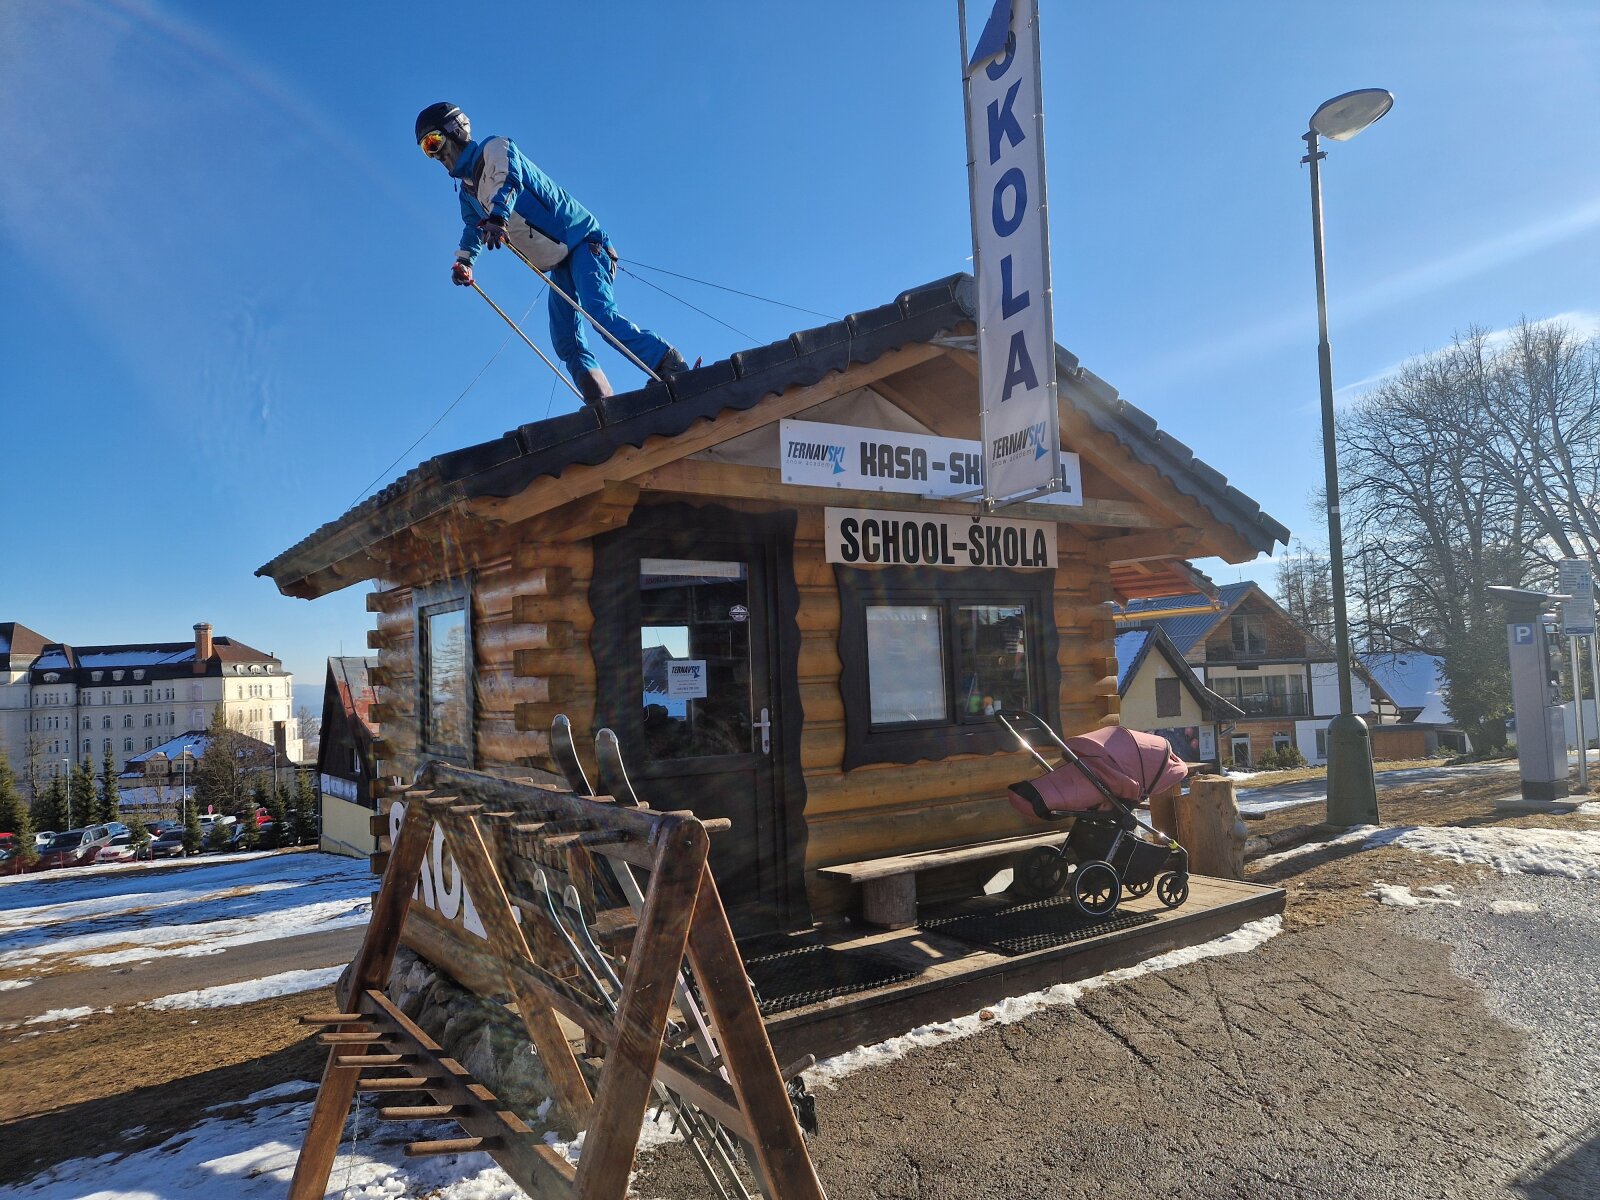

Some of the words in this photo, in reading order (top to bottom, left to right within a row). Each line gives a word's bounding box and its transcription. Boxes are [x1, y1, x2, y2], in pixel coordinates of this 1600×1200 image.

[788, 441, 846, 463] TERNAVSKI
[993, 421, 1046, 460] TERNAVSKI
[840, 516, 1048, 567] SCHOOL-ŠKOLA
[1515, 626, 1531, 643] P
